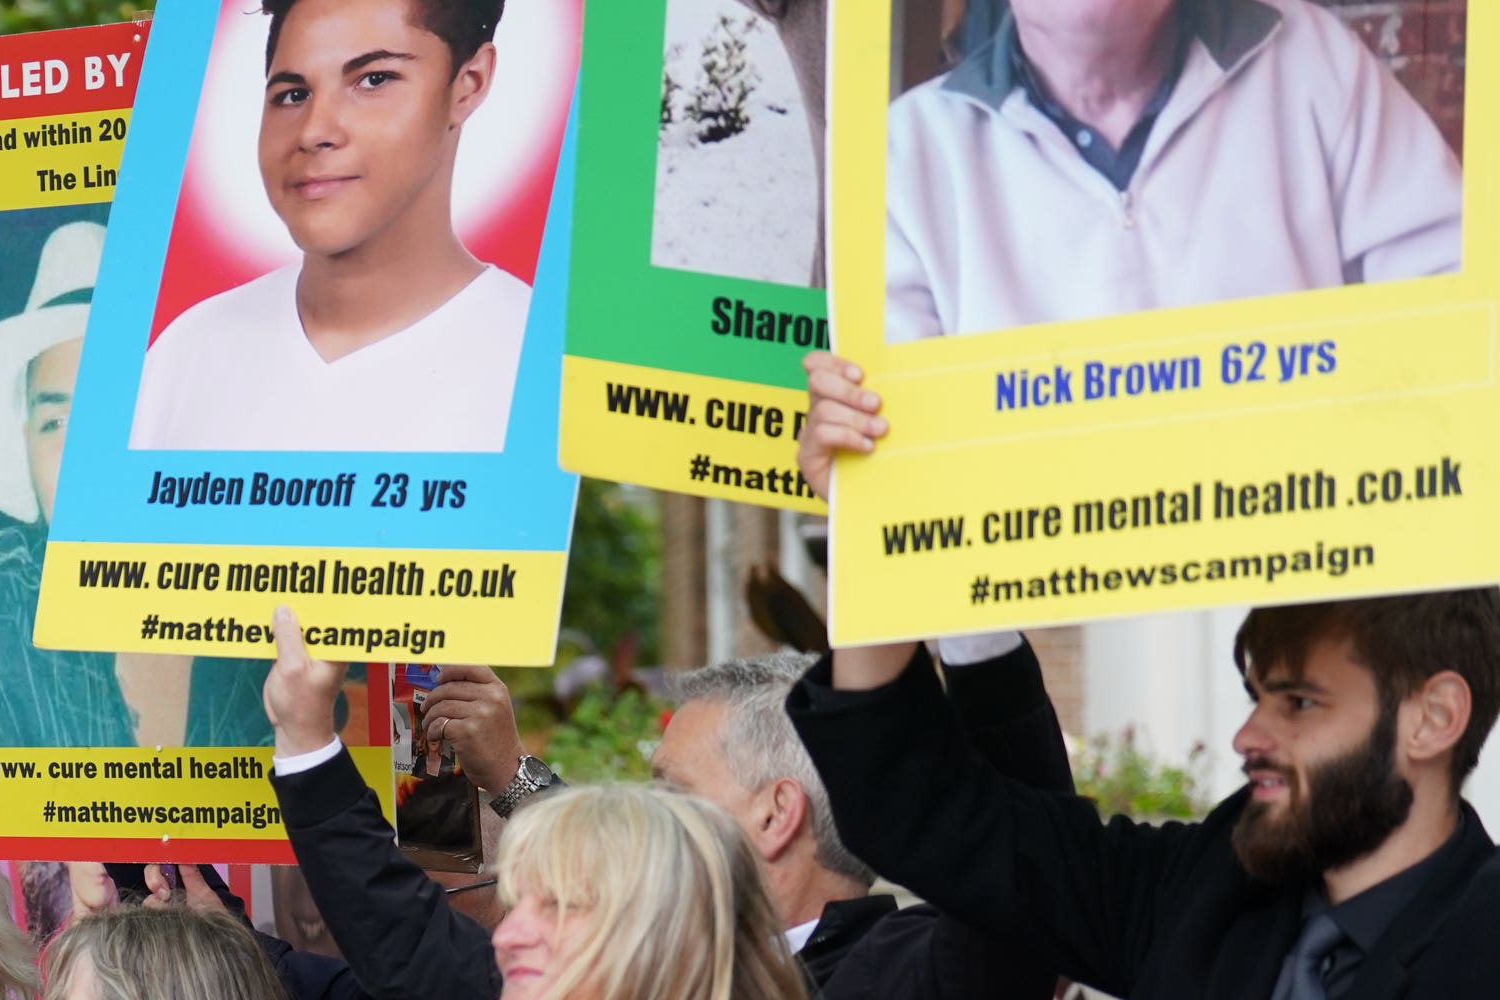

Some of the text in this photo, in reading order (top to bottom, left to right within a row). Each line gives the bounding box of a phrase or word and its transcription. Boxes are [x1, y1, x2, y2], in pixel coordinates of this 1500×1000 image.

[84, 52, 132, 91] BY
[23, 121, 92, 149] within
[98, 117, 126, 142] 20
[36, 169, 76, 192] The
[996, 340, 1338, 411] Nick Brown 62 yrs
[606, 381, 696, 425] www.
[705, 398, 784, 438] cure
[148, 470, 468, 512] Jayden Booroff 23 yrs
[882, 456, 1462, 556] www. cure mental health .co.uk
[78, 558, 516, 599] www. cure mental health .co.uk
[970, 541, 1375, 605] #matthewscampaign
[49, 761, 97, 780] cure
[103, 757, 182, 780] mental
[189, 757, 264, 780] health
[44, 800, 281, 829] #matthewscampaign
